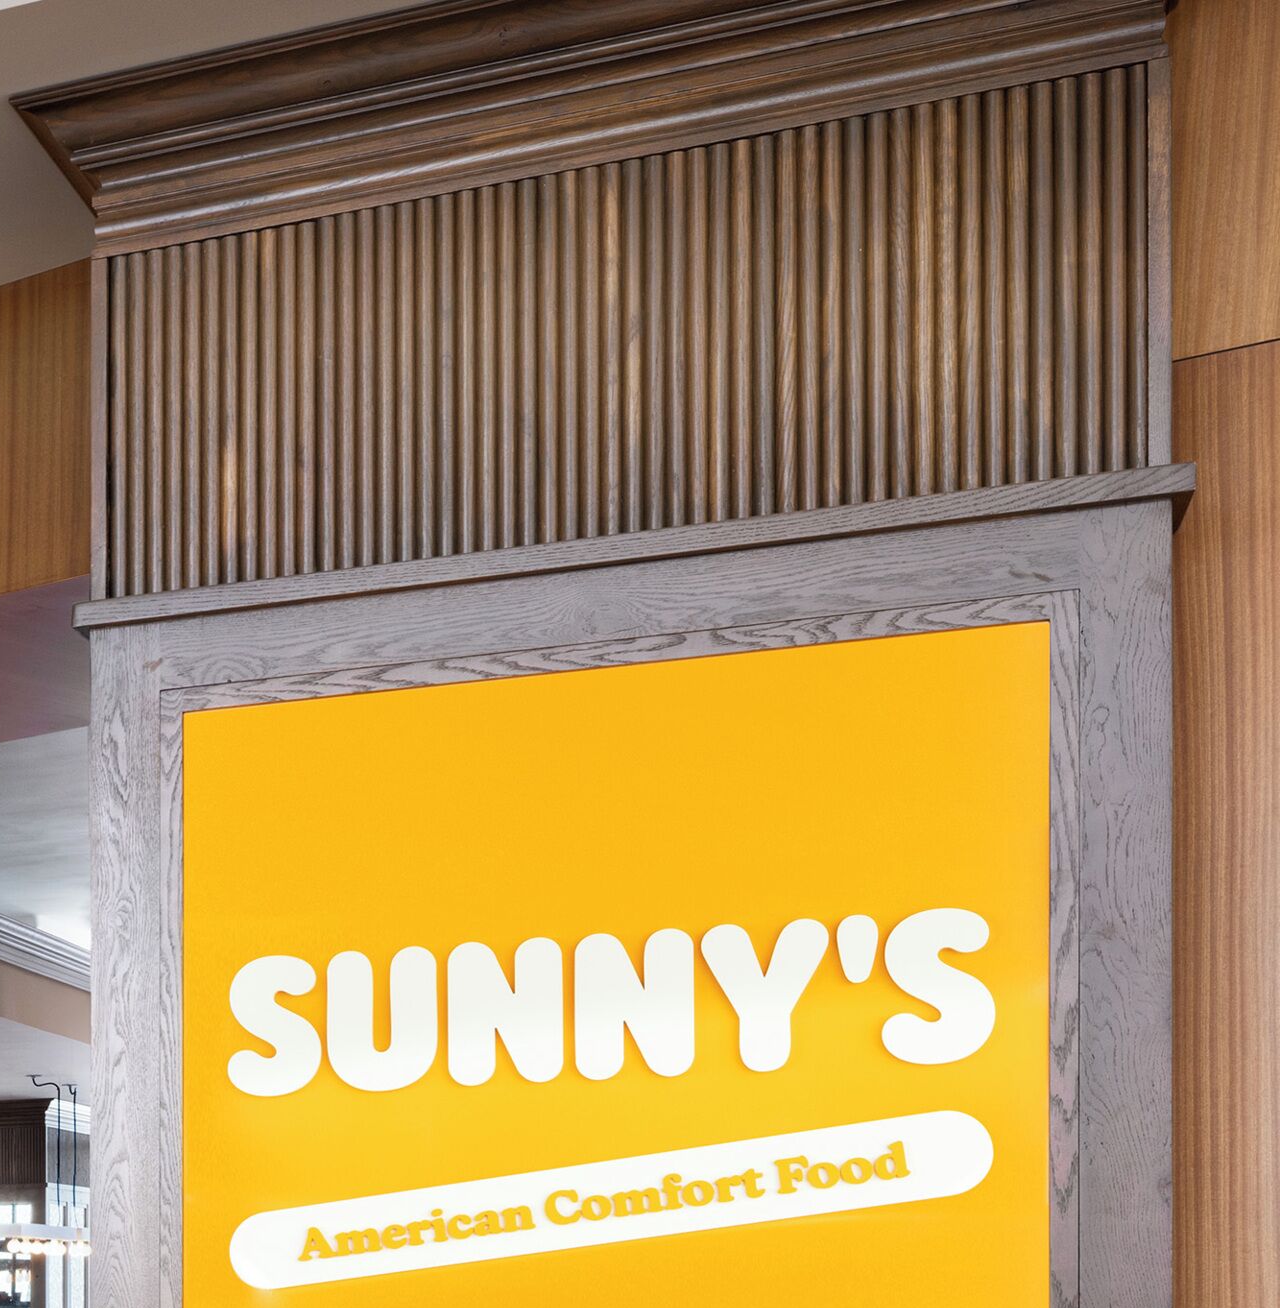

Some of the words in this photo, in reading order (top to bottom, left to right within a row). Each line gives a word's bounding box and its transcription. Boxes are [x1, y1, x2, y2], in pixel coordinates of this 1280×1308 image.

[227, 907, 996, 1096] SUNNY'S
[297, 1204, 534, 1262] American
[544, 1168, 764, 1226] Comfort
[776, 1142, 910, 1194] Food
